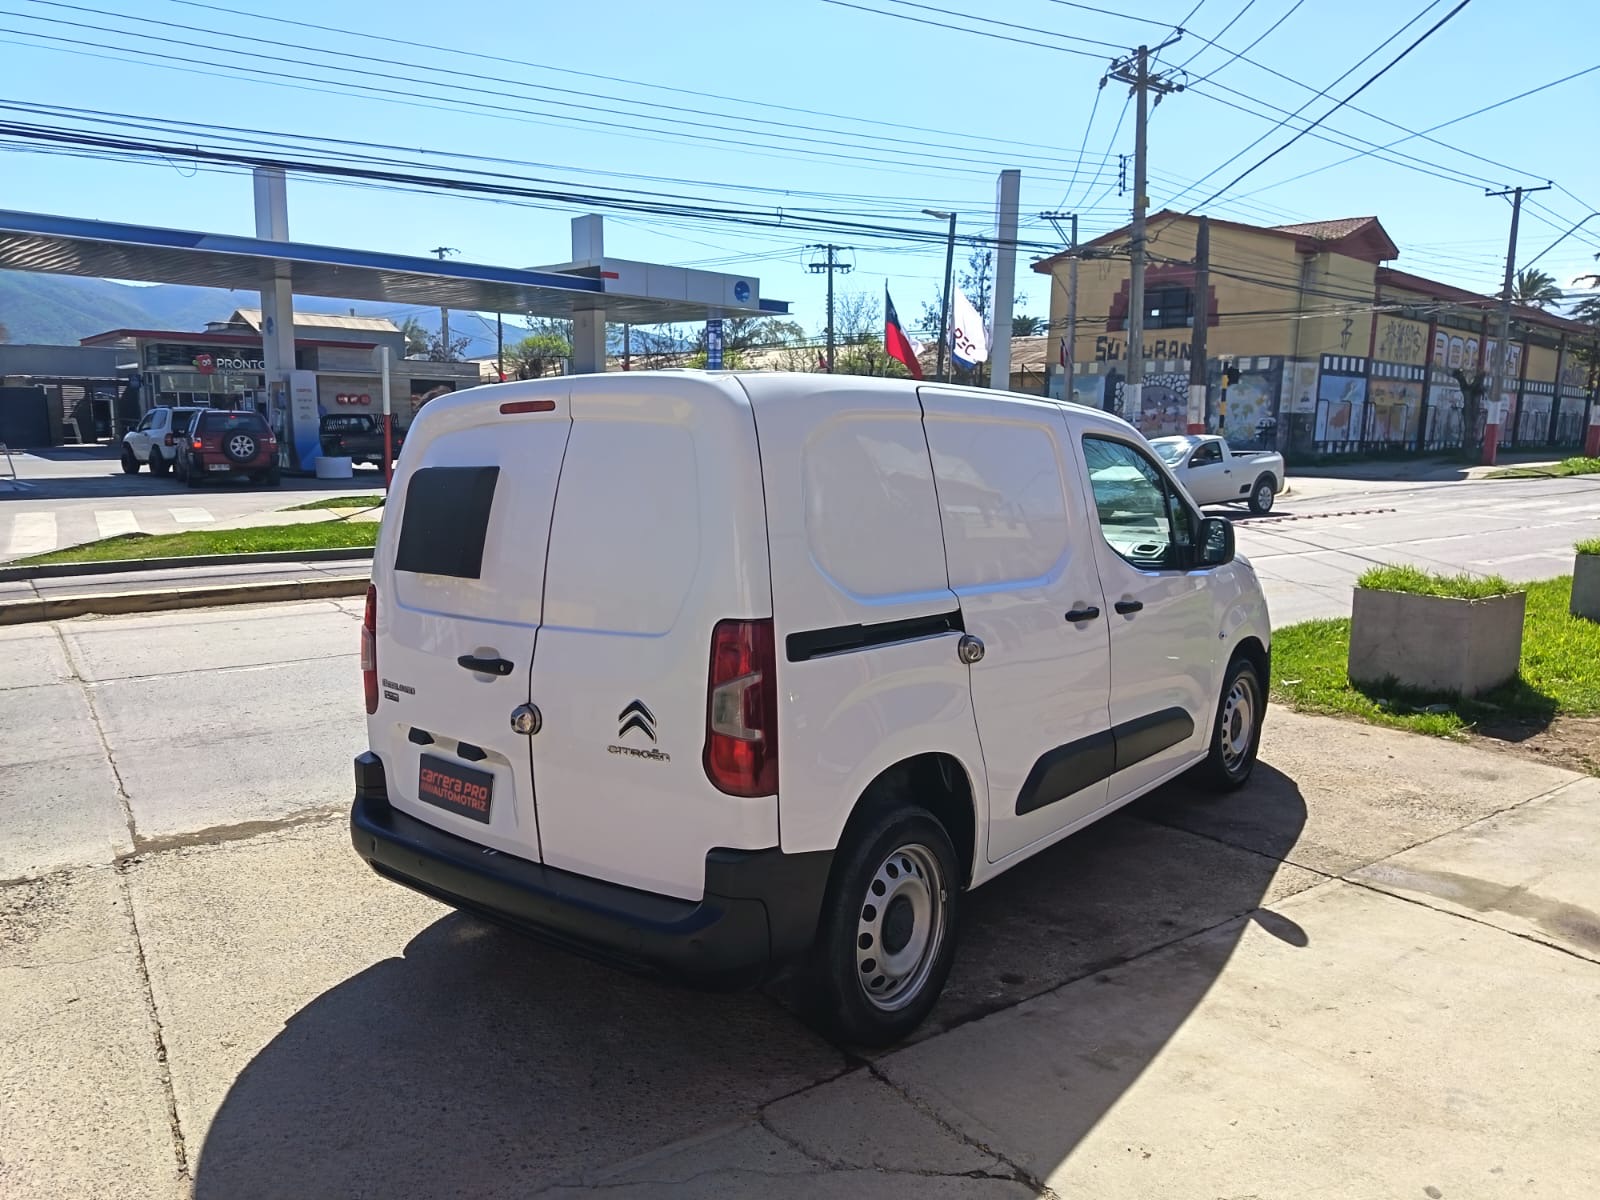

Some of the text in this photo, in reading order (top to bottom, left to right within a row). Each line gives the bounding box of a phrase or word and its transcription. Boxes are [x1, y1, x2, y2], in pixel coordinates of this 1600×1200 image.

[951, 327, 977, 357] PEC
[216, 358, 266, 370] PRONTO
[421, 767, 488, 801] carrera PRO
[431, 785, 487, 812] AUTOMOTRIZ
